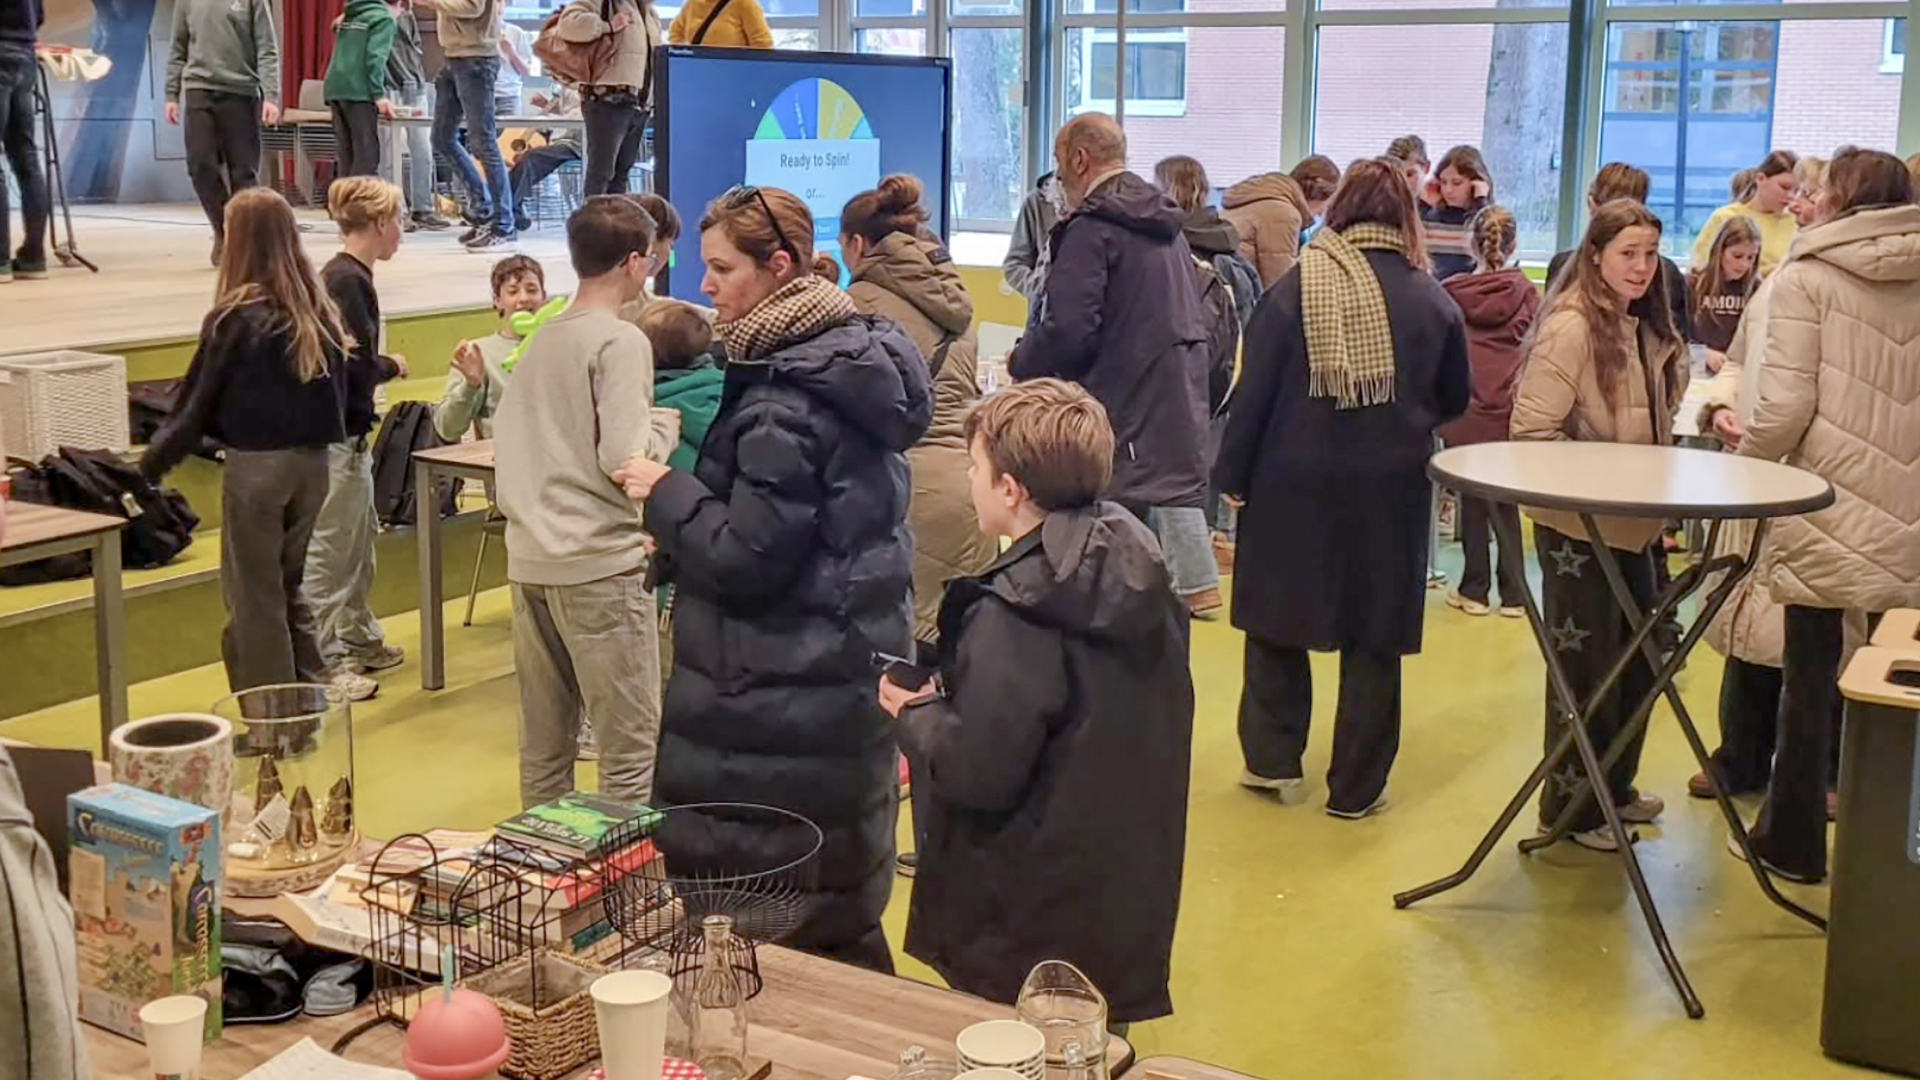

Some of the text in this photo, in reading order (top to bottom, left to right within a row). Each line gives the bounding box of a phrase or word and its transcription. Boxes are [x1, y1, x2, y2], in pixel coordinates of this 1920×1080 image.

[780, 151, 850, 171] Ready to Spin!
